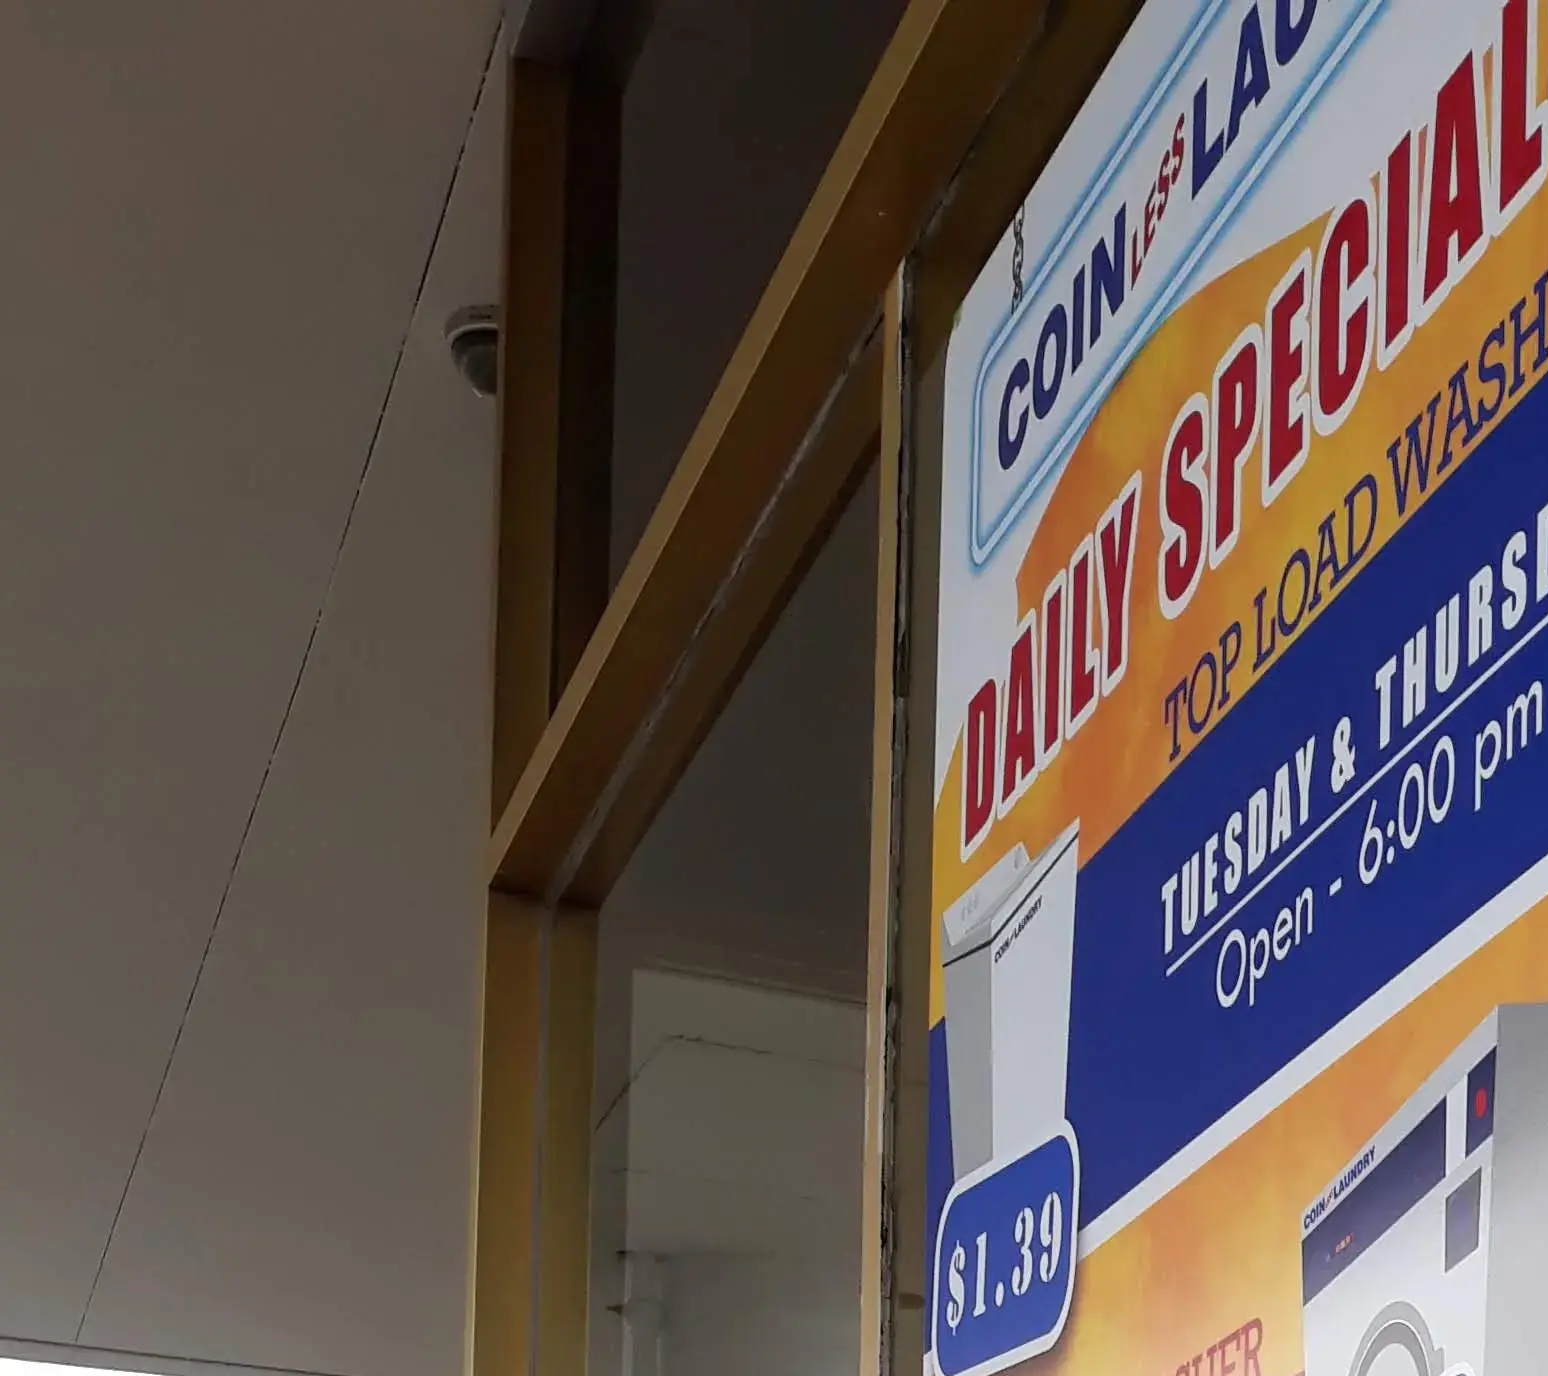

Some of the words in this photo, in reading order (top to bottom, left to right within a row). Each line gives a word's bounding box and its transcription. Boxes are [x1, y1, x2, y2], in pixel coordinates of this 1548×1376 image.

[962, 483, 1138, 842] DAILY
[1164, 621, 1242, 763] TOP
[1252, 475, 1379, 670] LOAD
[1161, 741, 1314, 955] TUESDAY
[1330, 717, 1357, 793] &
[1216, 892, 1314, 1008] Open
[1358, 736, 1455, 887] 6:00
[1474, 679, 1545, 812] pm
[945, 1191, 1062, 1340] $1.39
[1303, 1197, 1326, 1230] COIN
[1333, 1144, 1376, 1199] LAUNDRY
